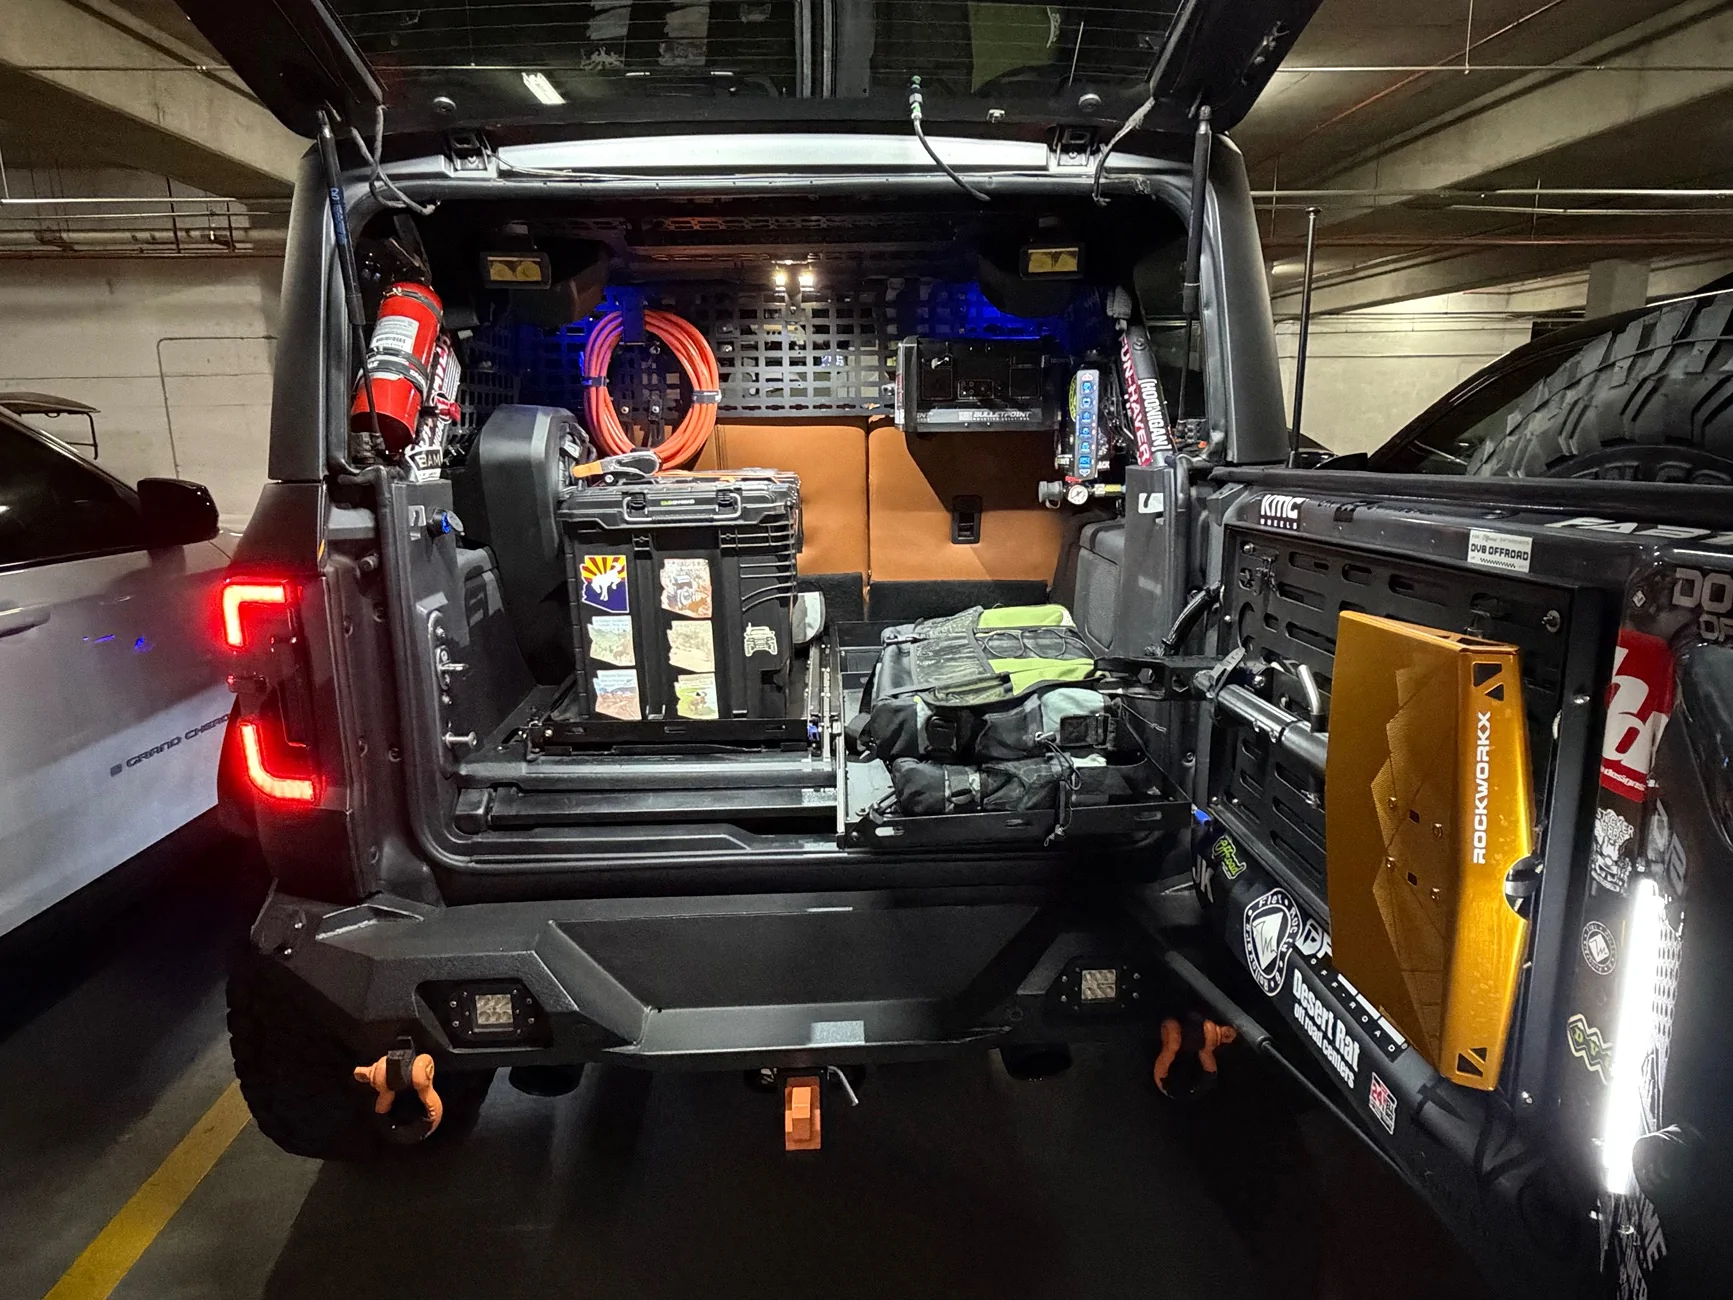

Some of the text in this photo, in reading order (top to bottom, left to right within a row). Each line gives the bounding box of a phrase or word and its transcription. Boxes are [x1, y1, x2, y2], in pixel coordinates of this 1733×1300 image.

[1260, 493, 1307, 520] KMC
[1260, 518, 1298, 530] WHEELS
[1487, 544, 1529, 561] OFFROAD
[126, 736, 182, 768] GRAND
[1473, 711, 1491, 864] ROCKWORKX
[1292, 968, 1335, 1044] Desert
[1335, 1018, 1361, 1073] Rat
[1304, 1014, 1323, 1050] road
[1322, 1038, 1355, 1090] centers
